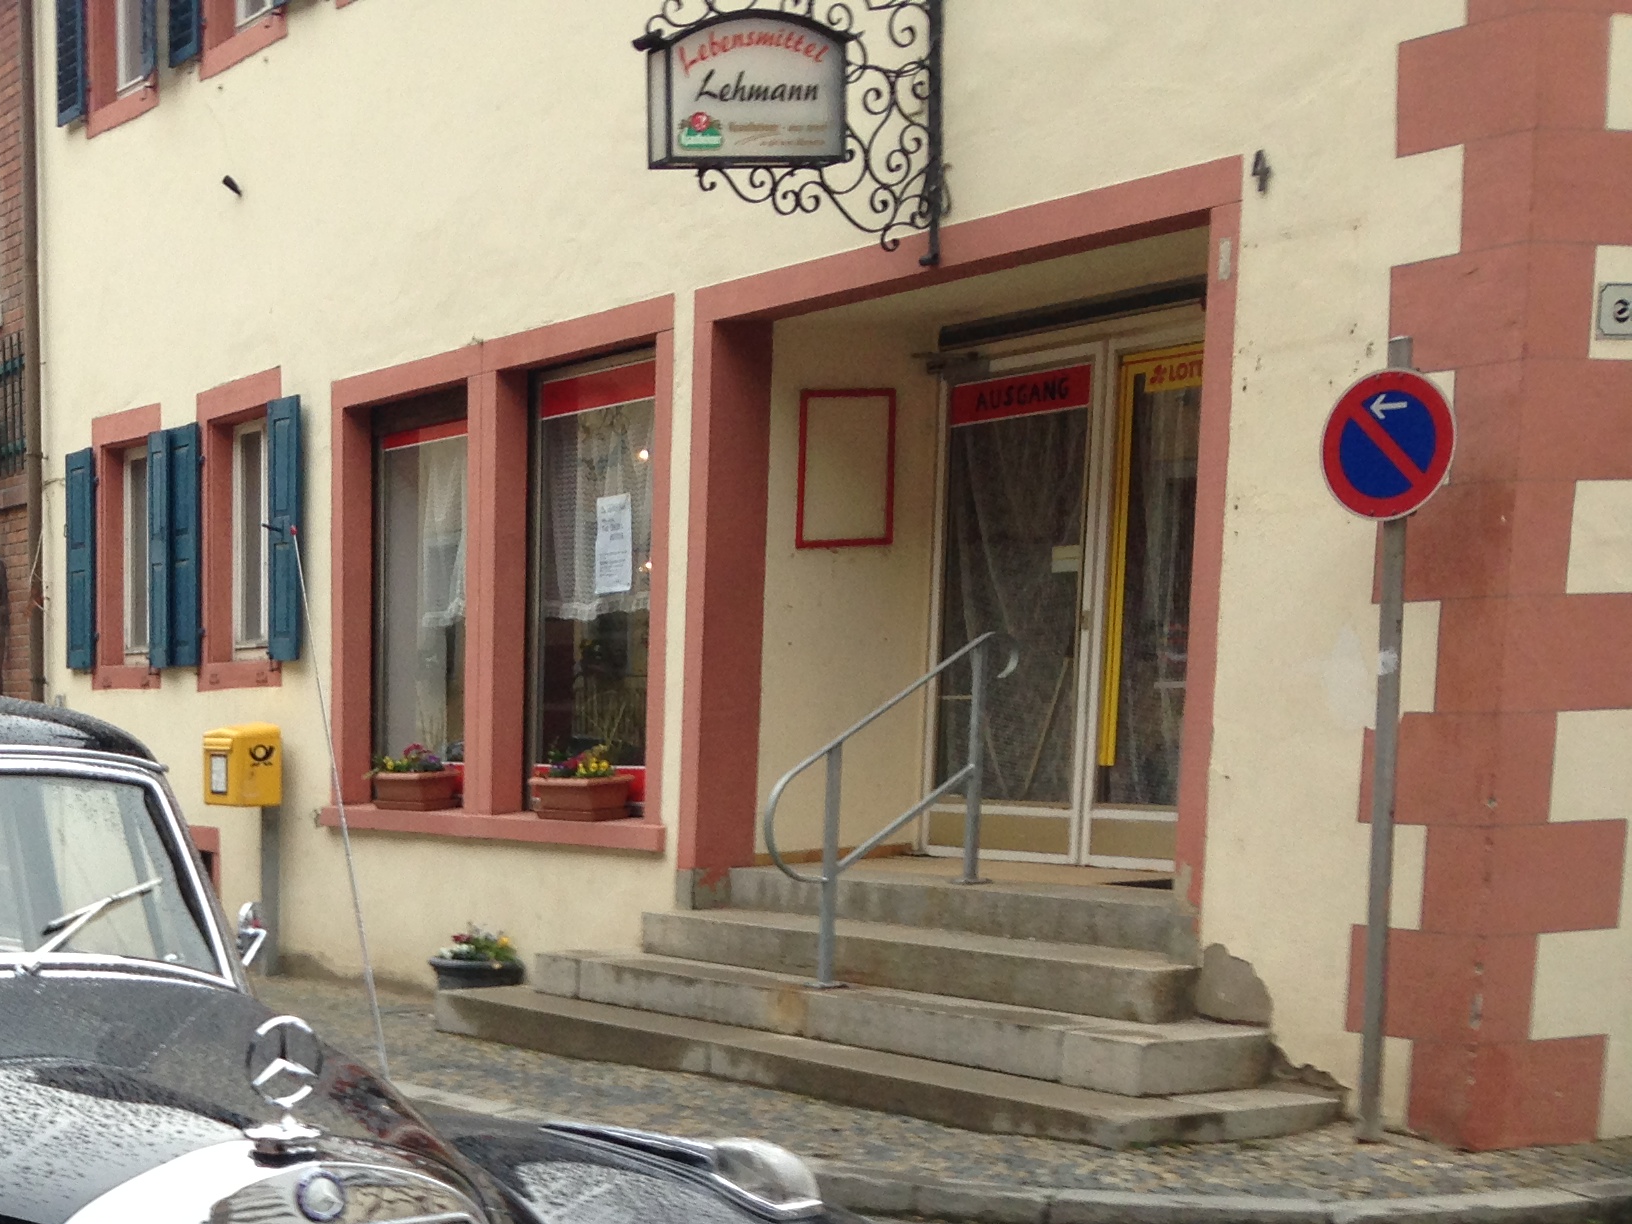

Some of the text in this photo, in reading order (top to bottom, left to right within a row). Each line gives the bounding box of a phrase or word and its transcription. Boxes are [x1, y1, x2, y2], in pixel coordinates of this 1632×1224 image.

[677, 29, 830, 78] Lebensmittel
[695, 68, 819, 102] Lehmann
[975, 377, 1070, 412] AUSGANG
